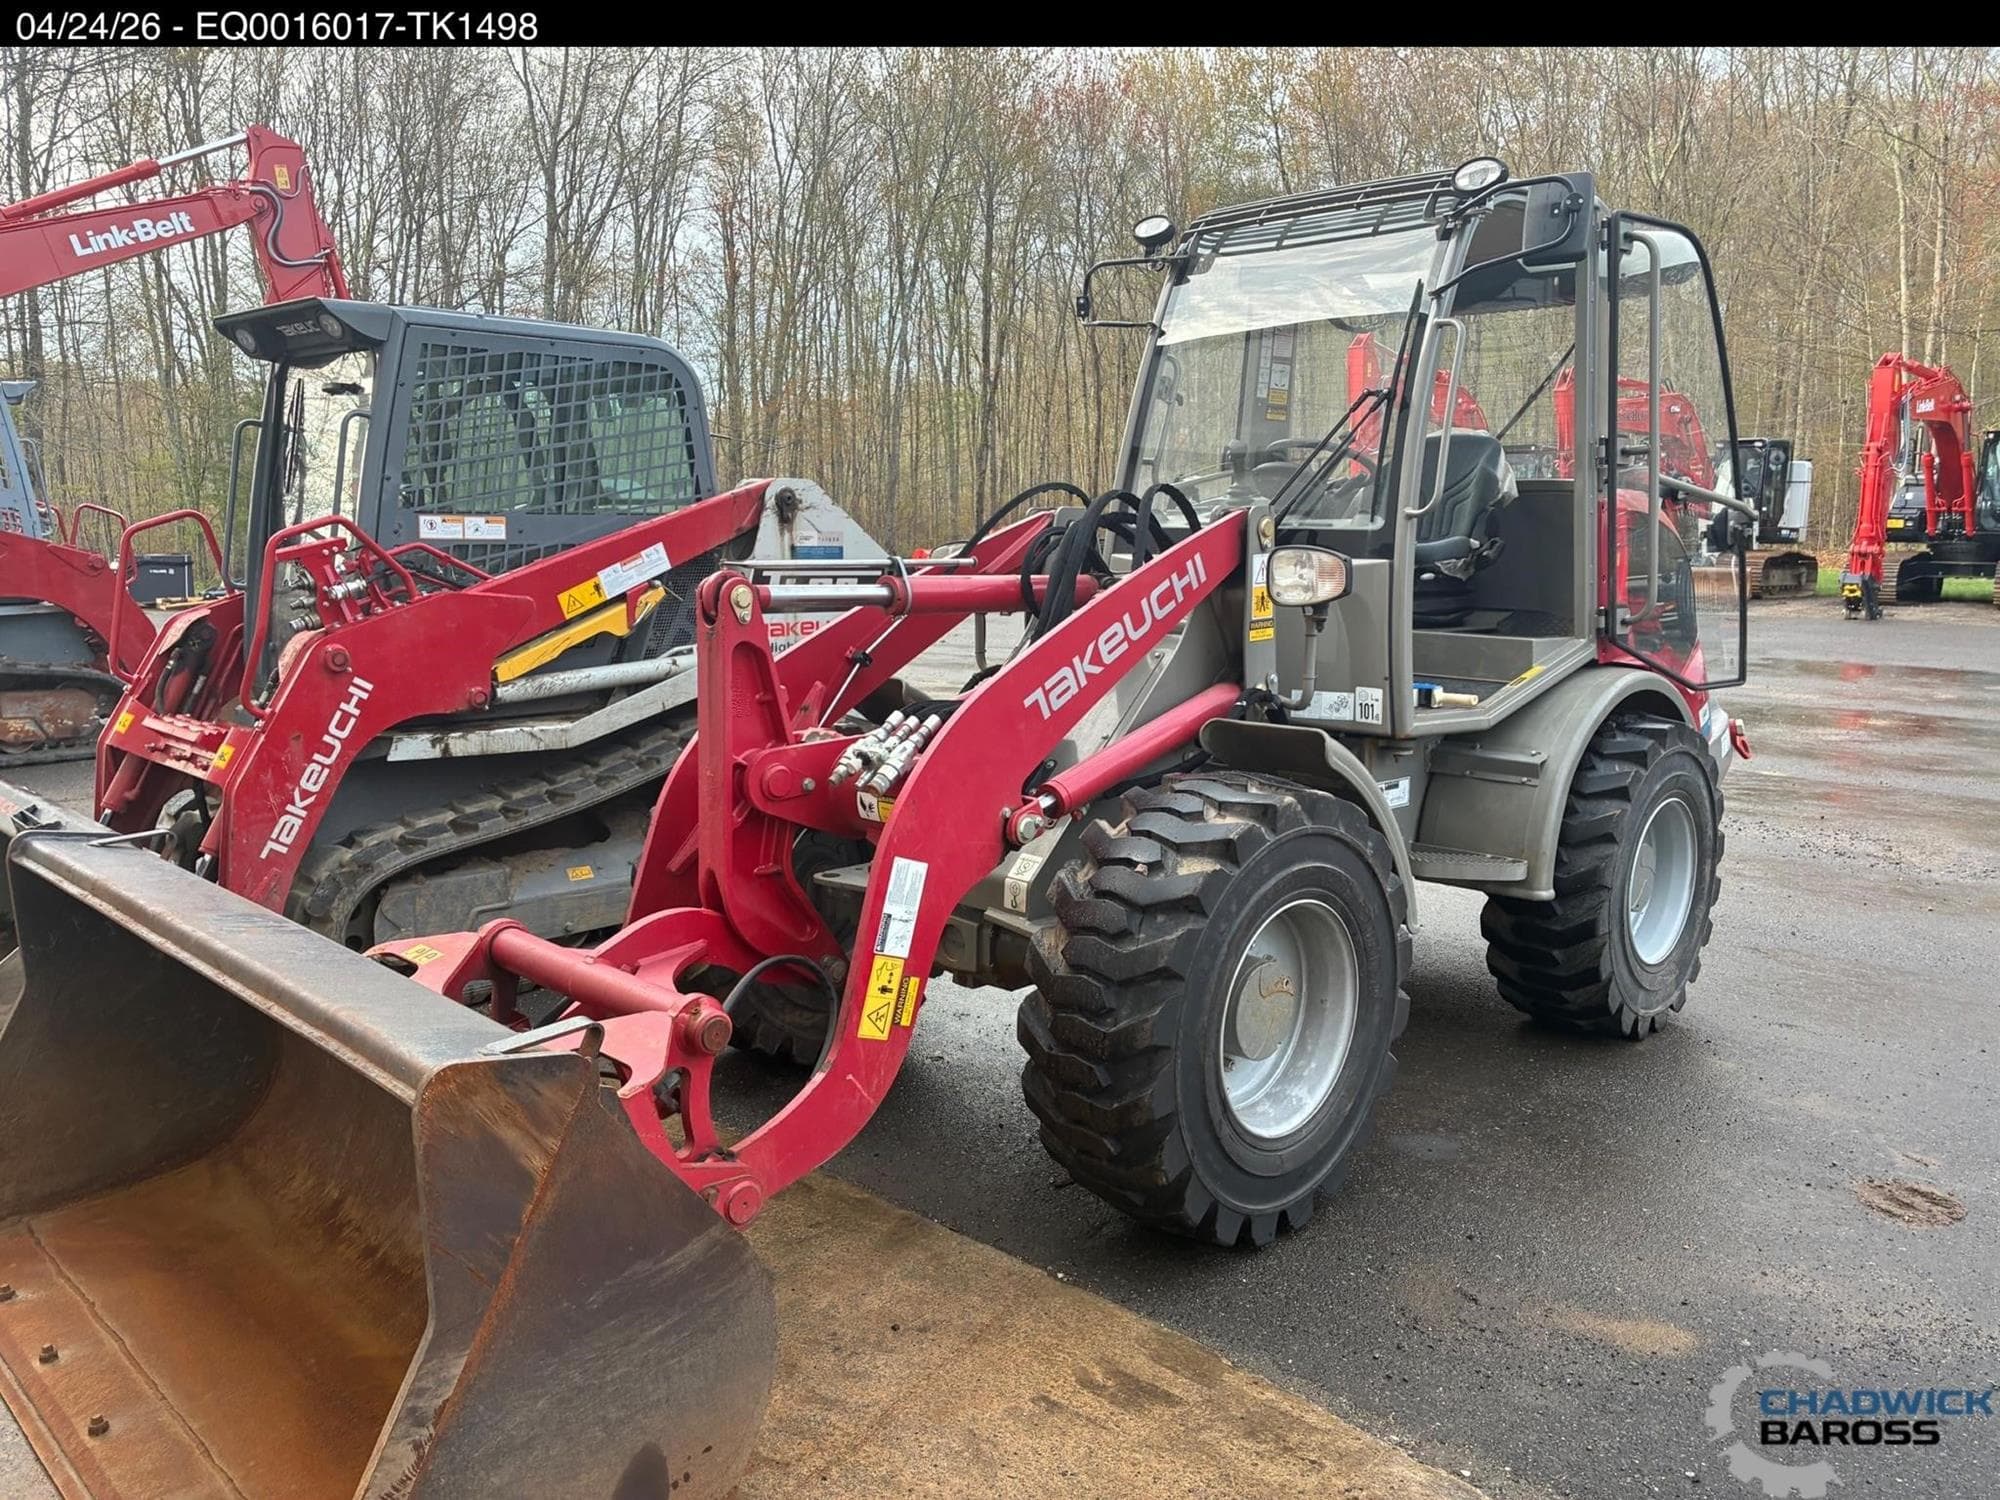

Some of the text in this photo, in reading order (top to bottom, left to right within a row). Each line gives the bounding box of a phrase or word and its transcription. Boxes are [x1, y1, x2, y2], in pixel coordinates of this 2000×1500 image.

[68, 211, 196, 257] Link-Belt
[1359, 702, 1375, 720] 101
[894, 977, 910, 1025] WARNING
